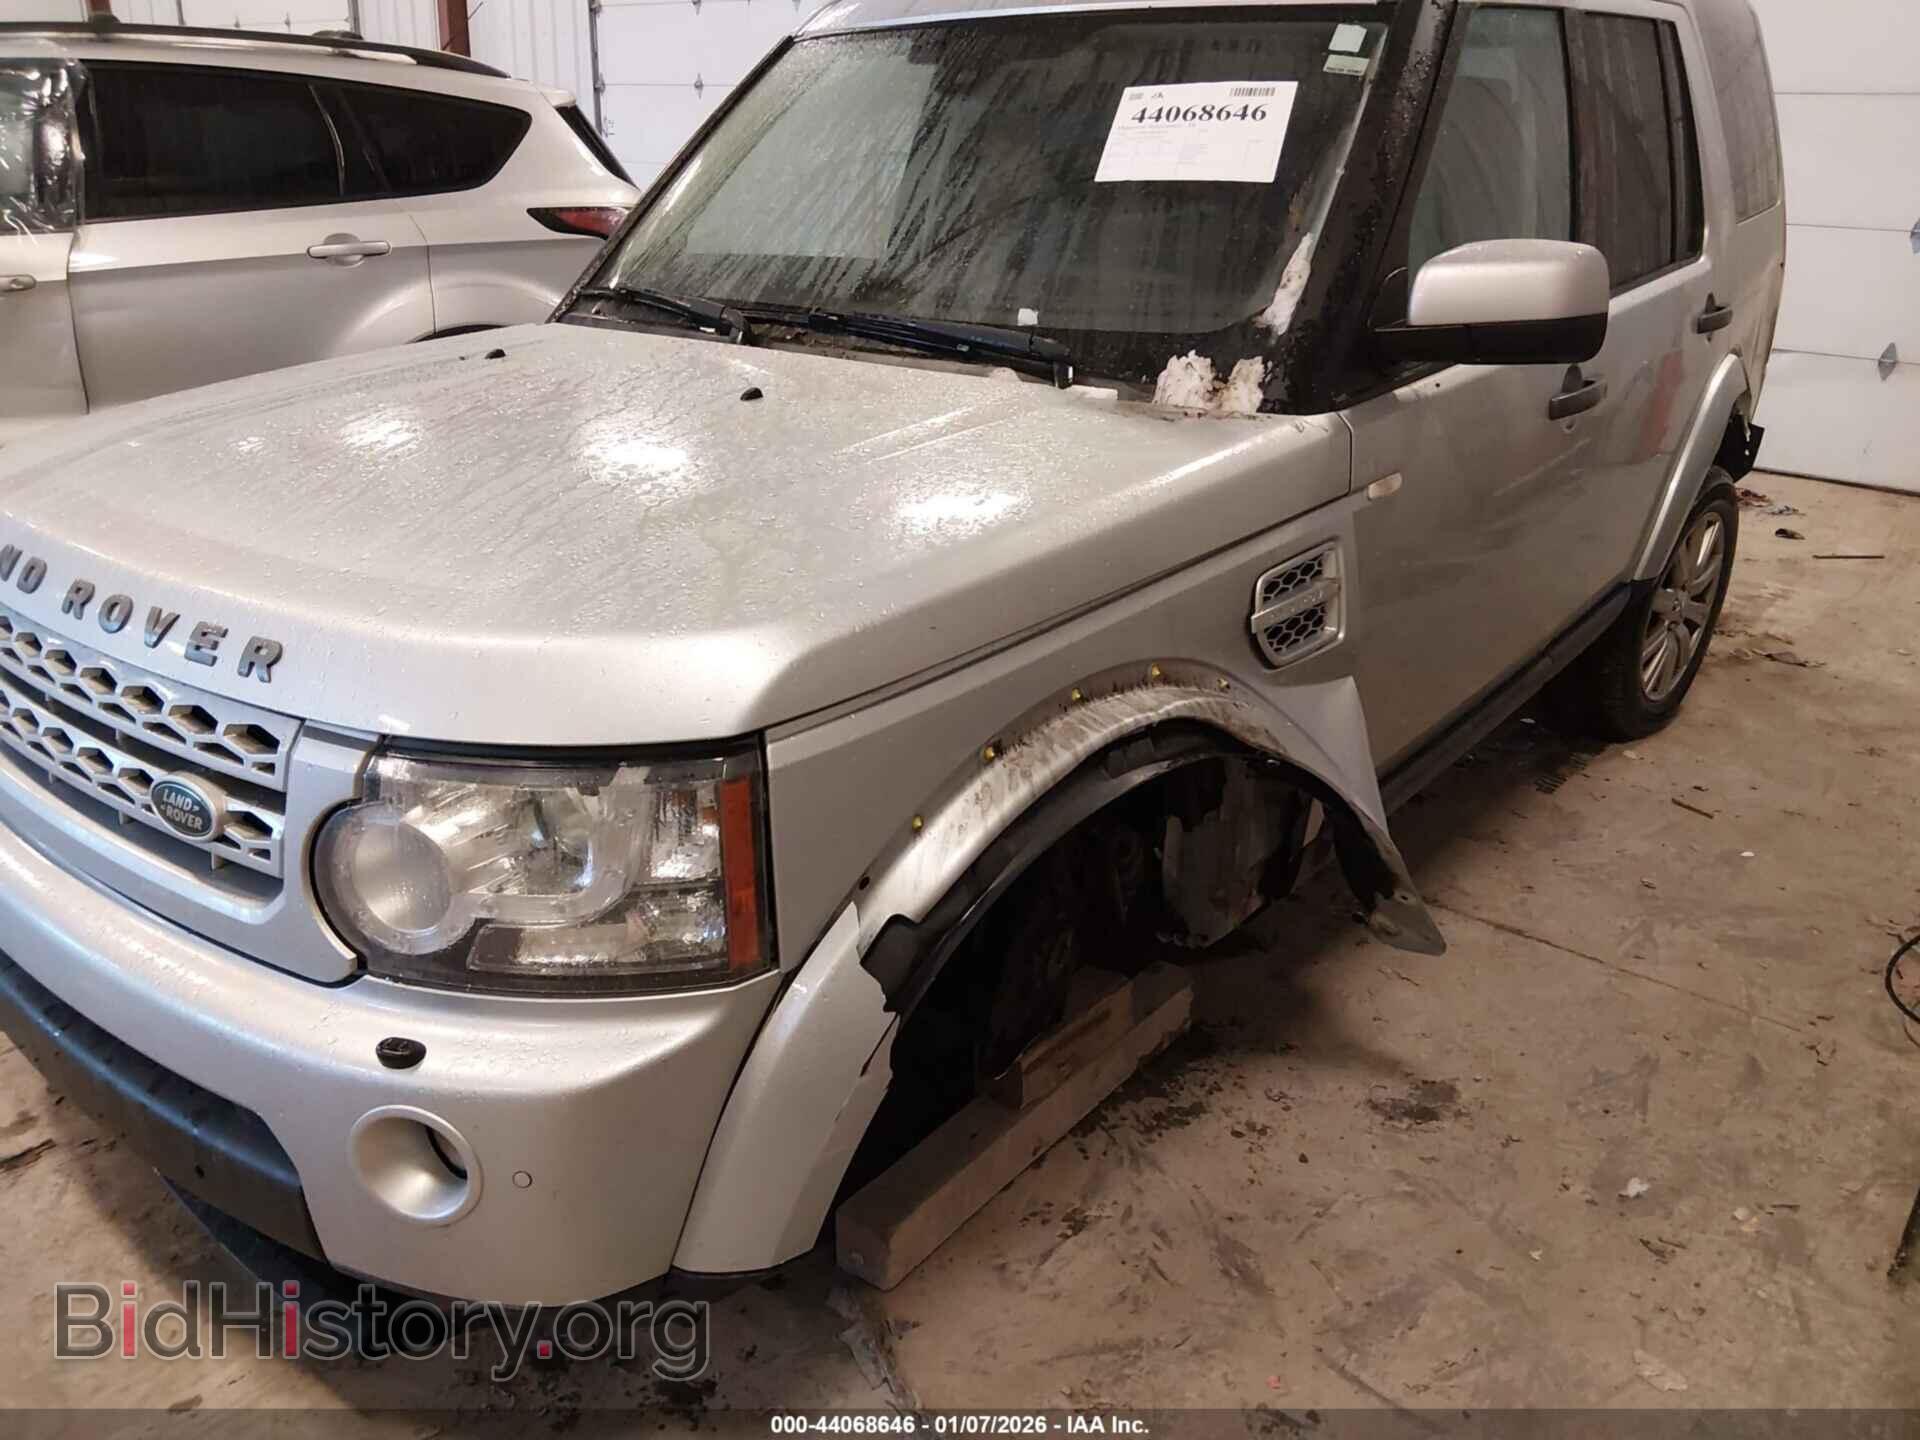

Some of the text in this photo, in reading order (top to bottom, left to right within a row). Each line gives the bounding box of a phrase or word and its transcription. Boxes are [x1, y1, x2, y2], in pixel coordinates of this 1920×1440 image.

[1131, 104, 1269, 124] 44068646
[61, 578, 284, 683] ROVER
[163, 788, 193, 812] LAND
[166, 804, 203, 831] ROVER
